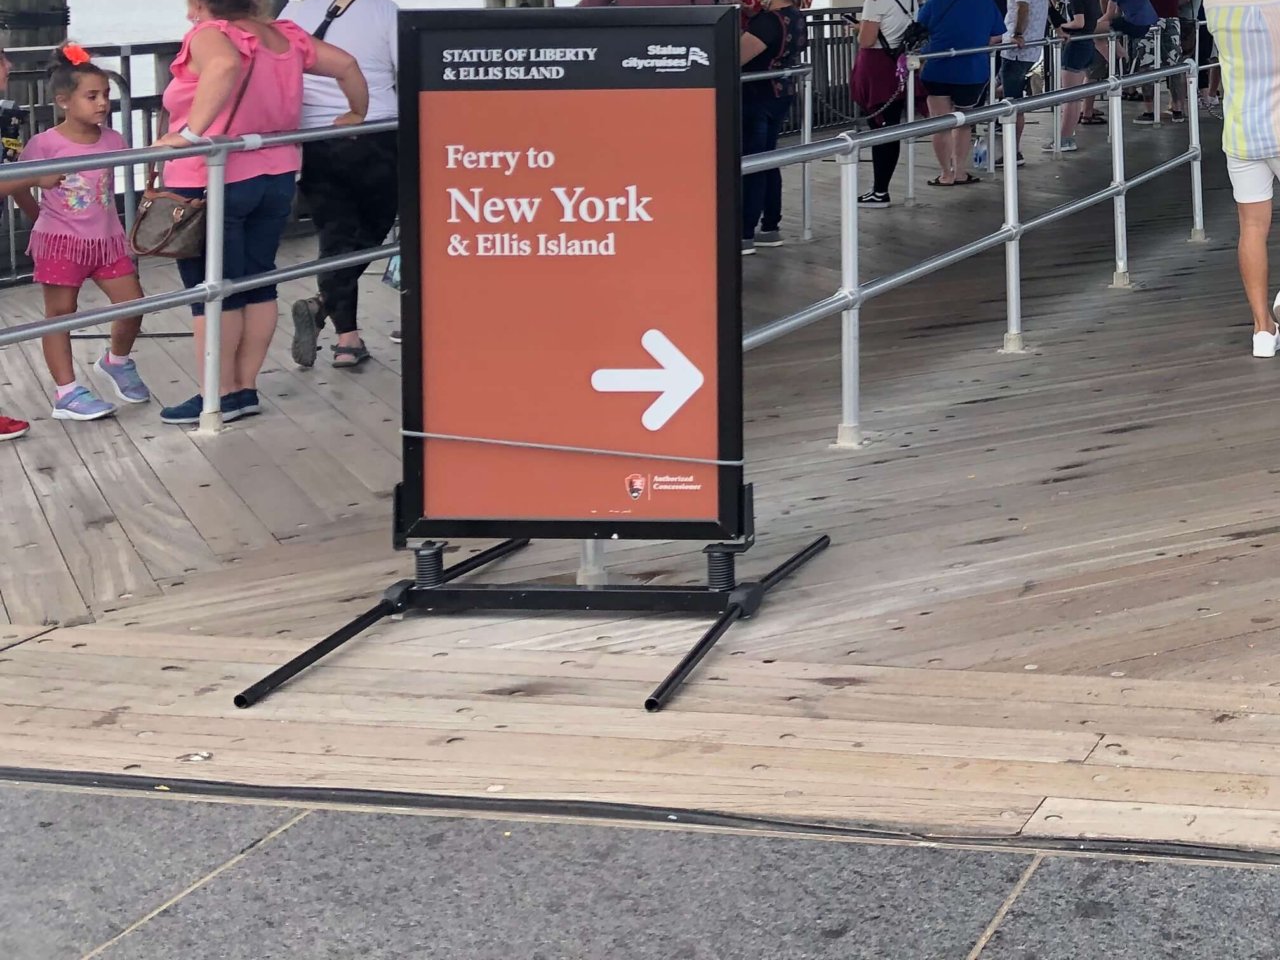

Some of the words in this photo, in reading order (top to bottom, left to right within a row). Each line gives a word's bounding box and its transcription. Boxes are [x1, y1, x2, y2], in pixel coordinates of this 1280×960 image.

[442, 49, 502, 63] STATUE
[504, 49, 527, 62] OF
[530, 48, 598, 62] LIBERTY
[647, 45, 686, 56] Statue
[622, 57, 687, 70] citycruises
[443, 67, 456, 81] &
[459, 67, 501, 80] ELLIS
[504, 66, 565, 80] ISLAND
[446, 145, 520, 175] Ferry
[527, 146, 555, 169] to
[446, 188, 541, 224] New
[551, 184, 653, 223] York
[447, 235, 469, 256] &
[477, 233, 532, 257] Ellis
[538, 232, 616, 256] Island
